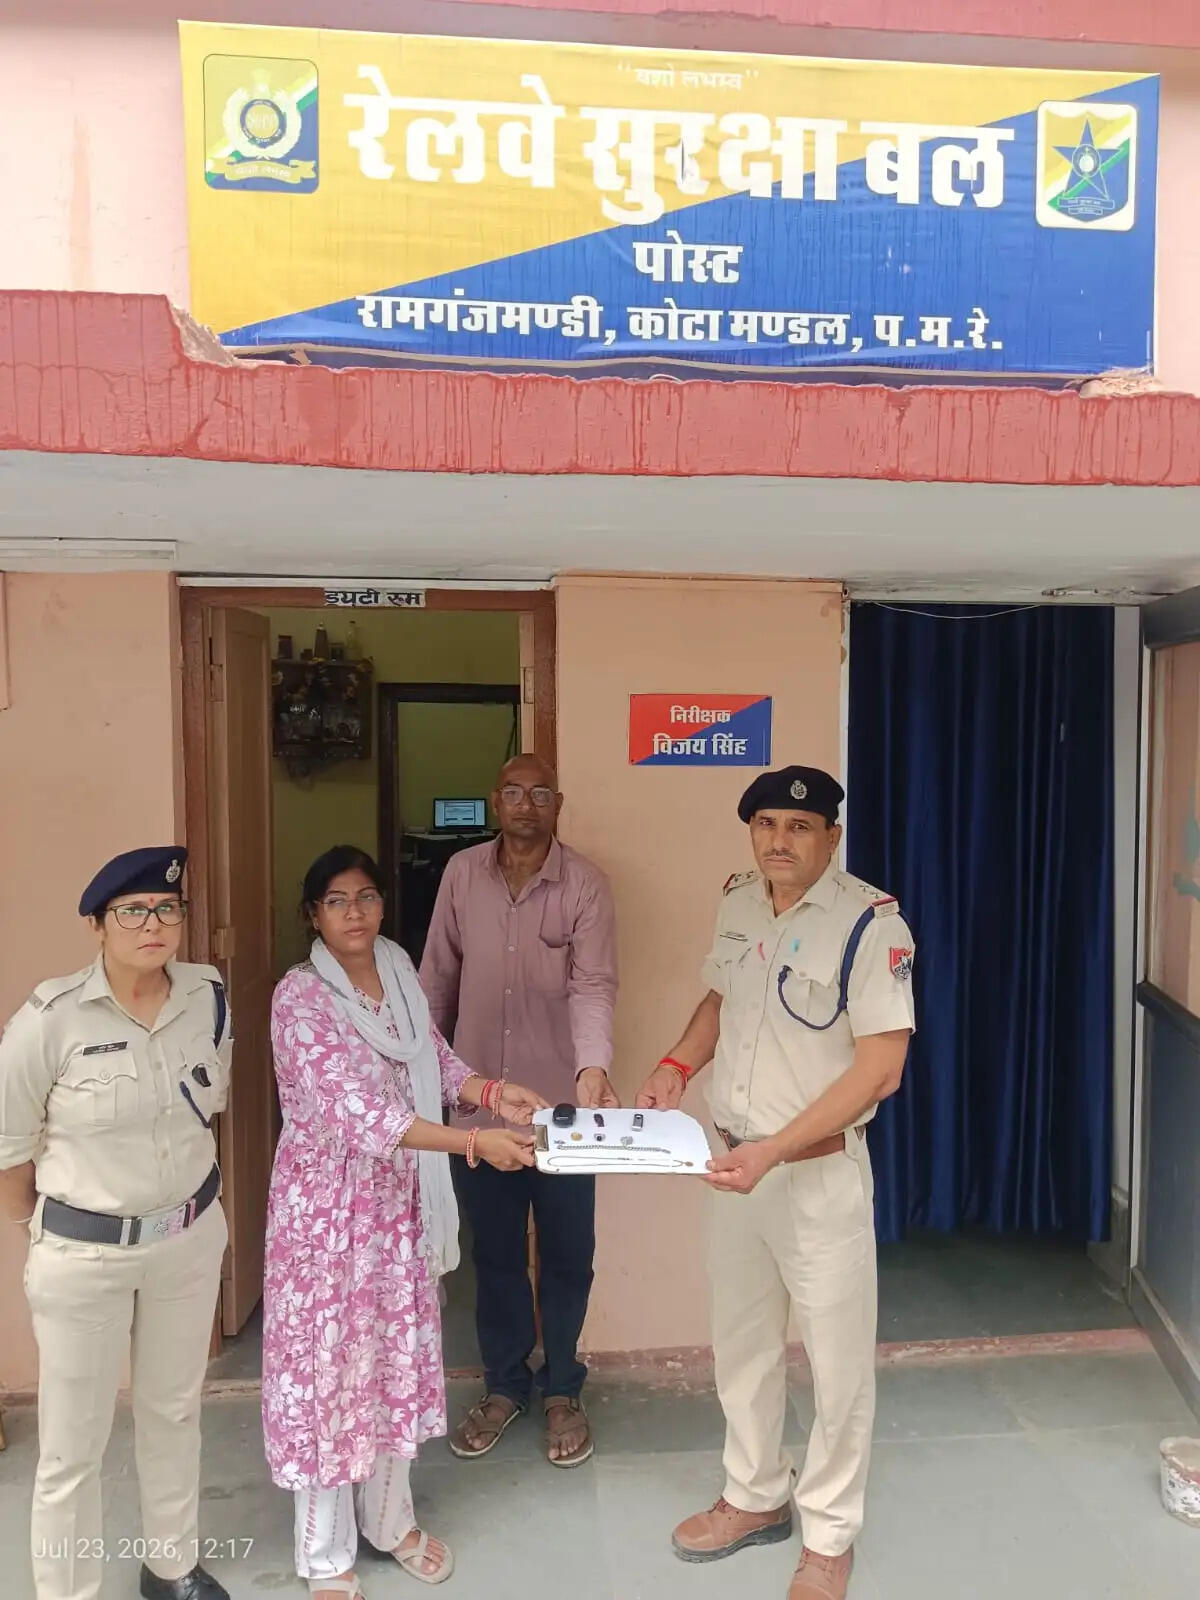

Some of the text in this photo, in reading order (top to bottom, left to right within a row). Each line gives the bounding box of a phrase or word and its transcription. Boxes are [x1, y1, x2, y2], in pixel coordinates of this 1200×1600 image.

[343, 65, 1015, 225] रेलवे सुरक्षा बल
[633, 230, 744, 284] पोस्ट
[356, 288, 1005, 353] रामगंजमण्डी, कोटा मण्डल, प.म.रे.
[670, 705, 732, 724] निरीक्षक
[653, 732, 748, 756] विजय सिंह
